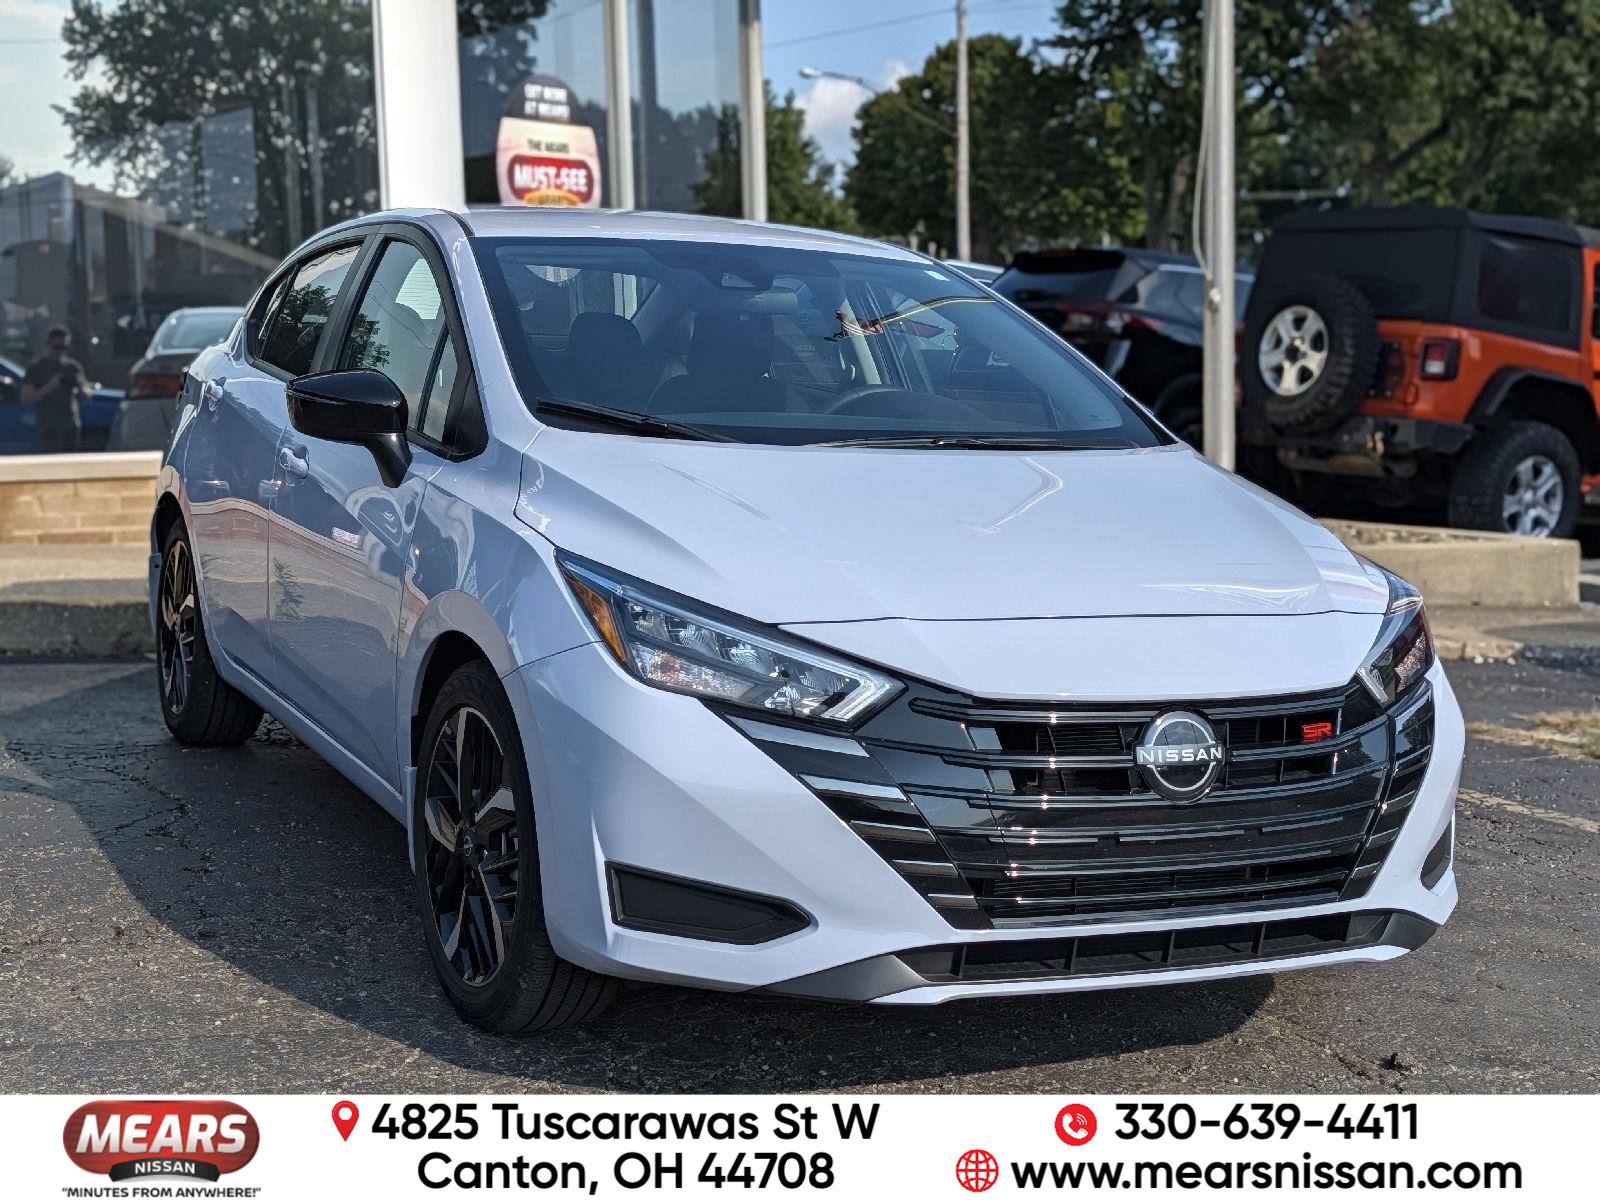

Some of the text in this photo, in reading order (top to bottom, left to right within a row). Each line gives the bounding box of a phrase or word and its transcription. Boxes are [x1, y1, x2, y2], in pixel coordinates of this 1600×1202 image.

[514, 164, 588, 193] MUST-SEE
[1302, 722, 1332, 739] SR
[1138, 746, 1222, 763] NISSAN
